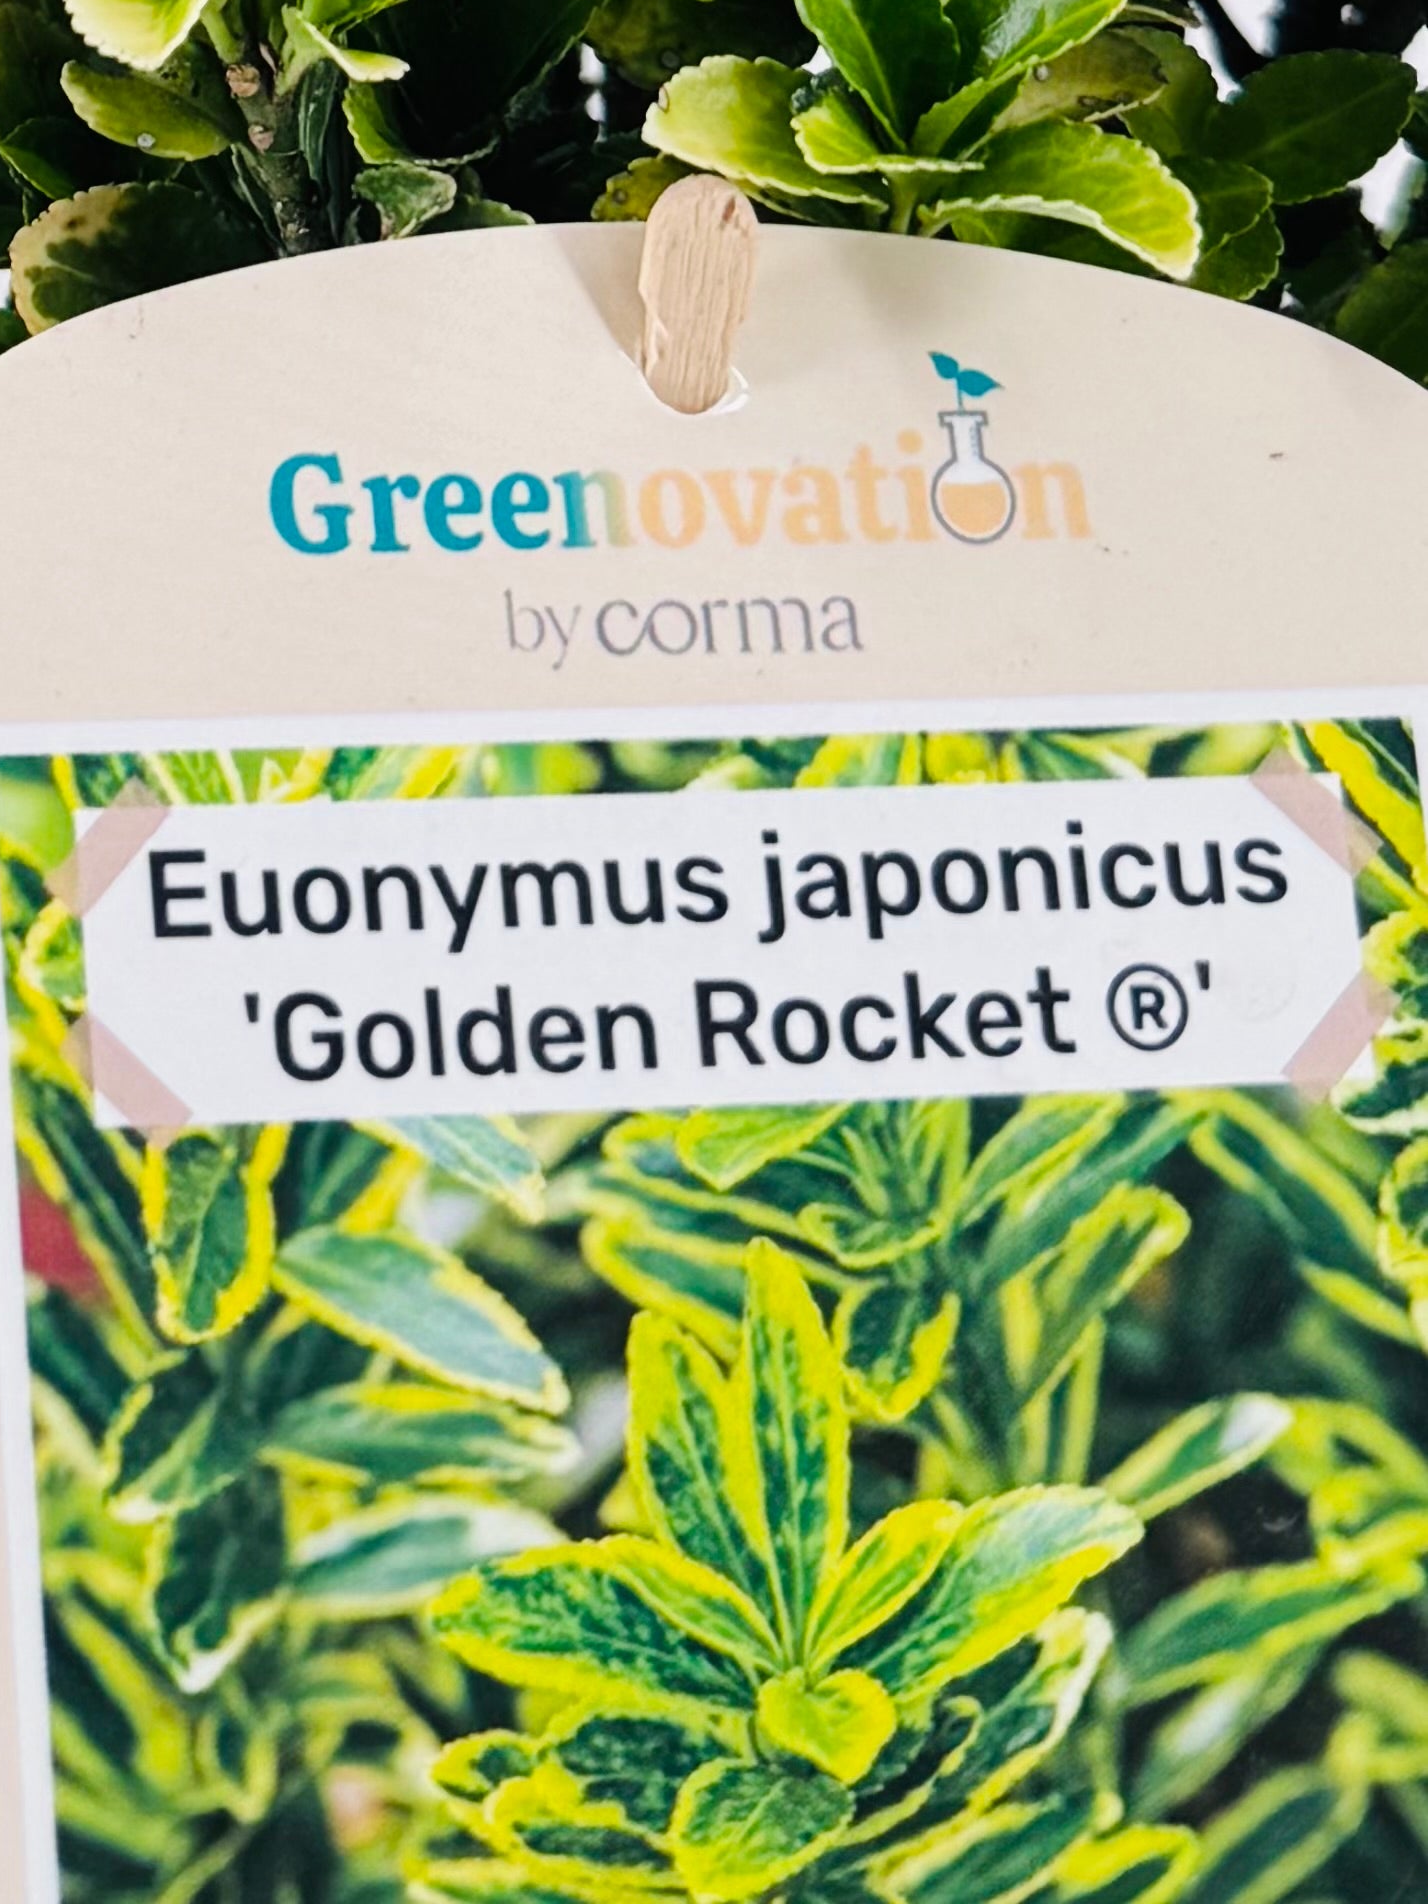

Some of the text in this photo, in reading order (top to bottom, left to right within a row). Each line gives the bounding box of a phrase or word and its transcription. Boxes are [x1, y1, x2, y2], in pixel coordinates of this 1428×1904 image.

[267, 410, 1091, 558] Greenovation
[502, 588, 866, 672] by corma
[147, 820, 1289, 955] Euonymus japonicus
[242, 984, 659, 1083] 'Golden
[693, 966, 1078, 1068] Rocket
